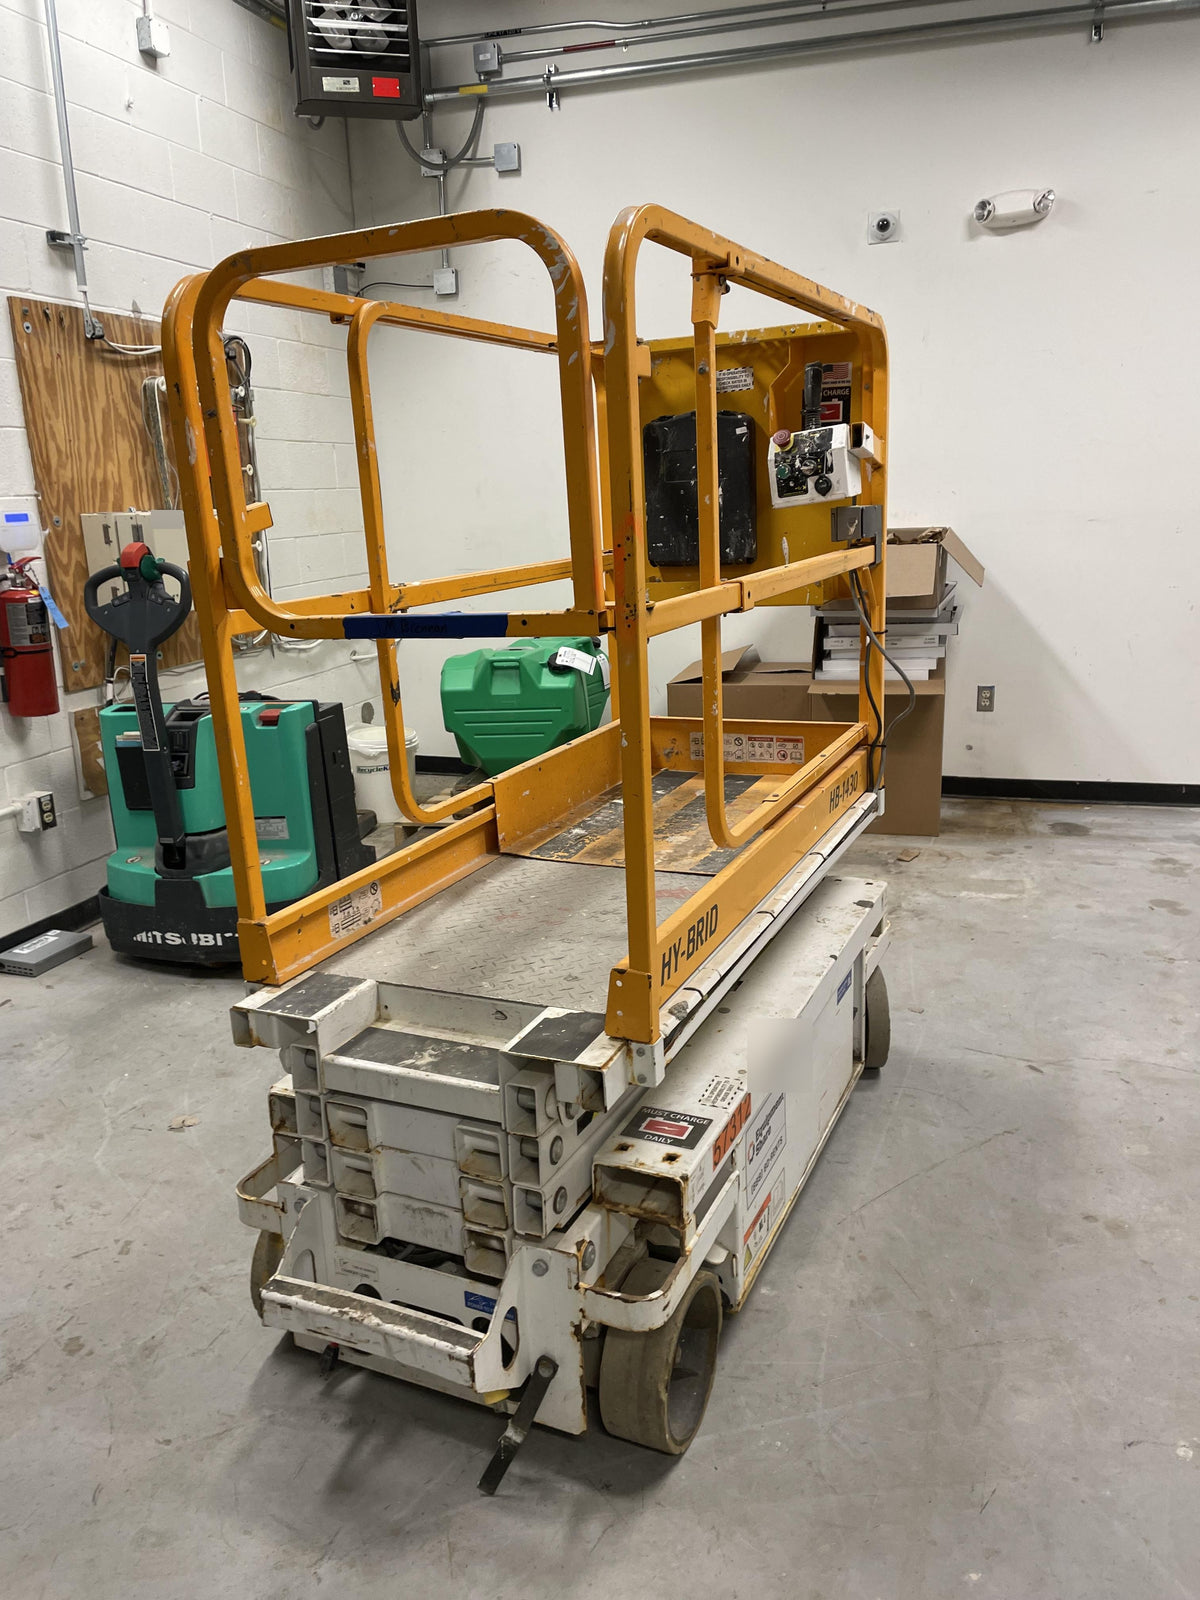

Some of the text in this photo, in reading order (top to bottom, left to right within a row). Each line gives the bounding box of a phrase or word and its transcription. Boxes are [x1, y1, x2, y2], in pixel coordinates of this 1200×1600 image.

[823, 387, 850, 397] CHARGE
[829, 770, 859, 814] HB-1430
[661, 903, 718, 987] HY-BRID
[641, 1107, 712, 1125] MUST CHARGE
[643, 1134, 674, 1144] DAILY
